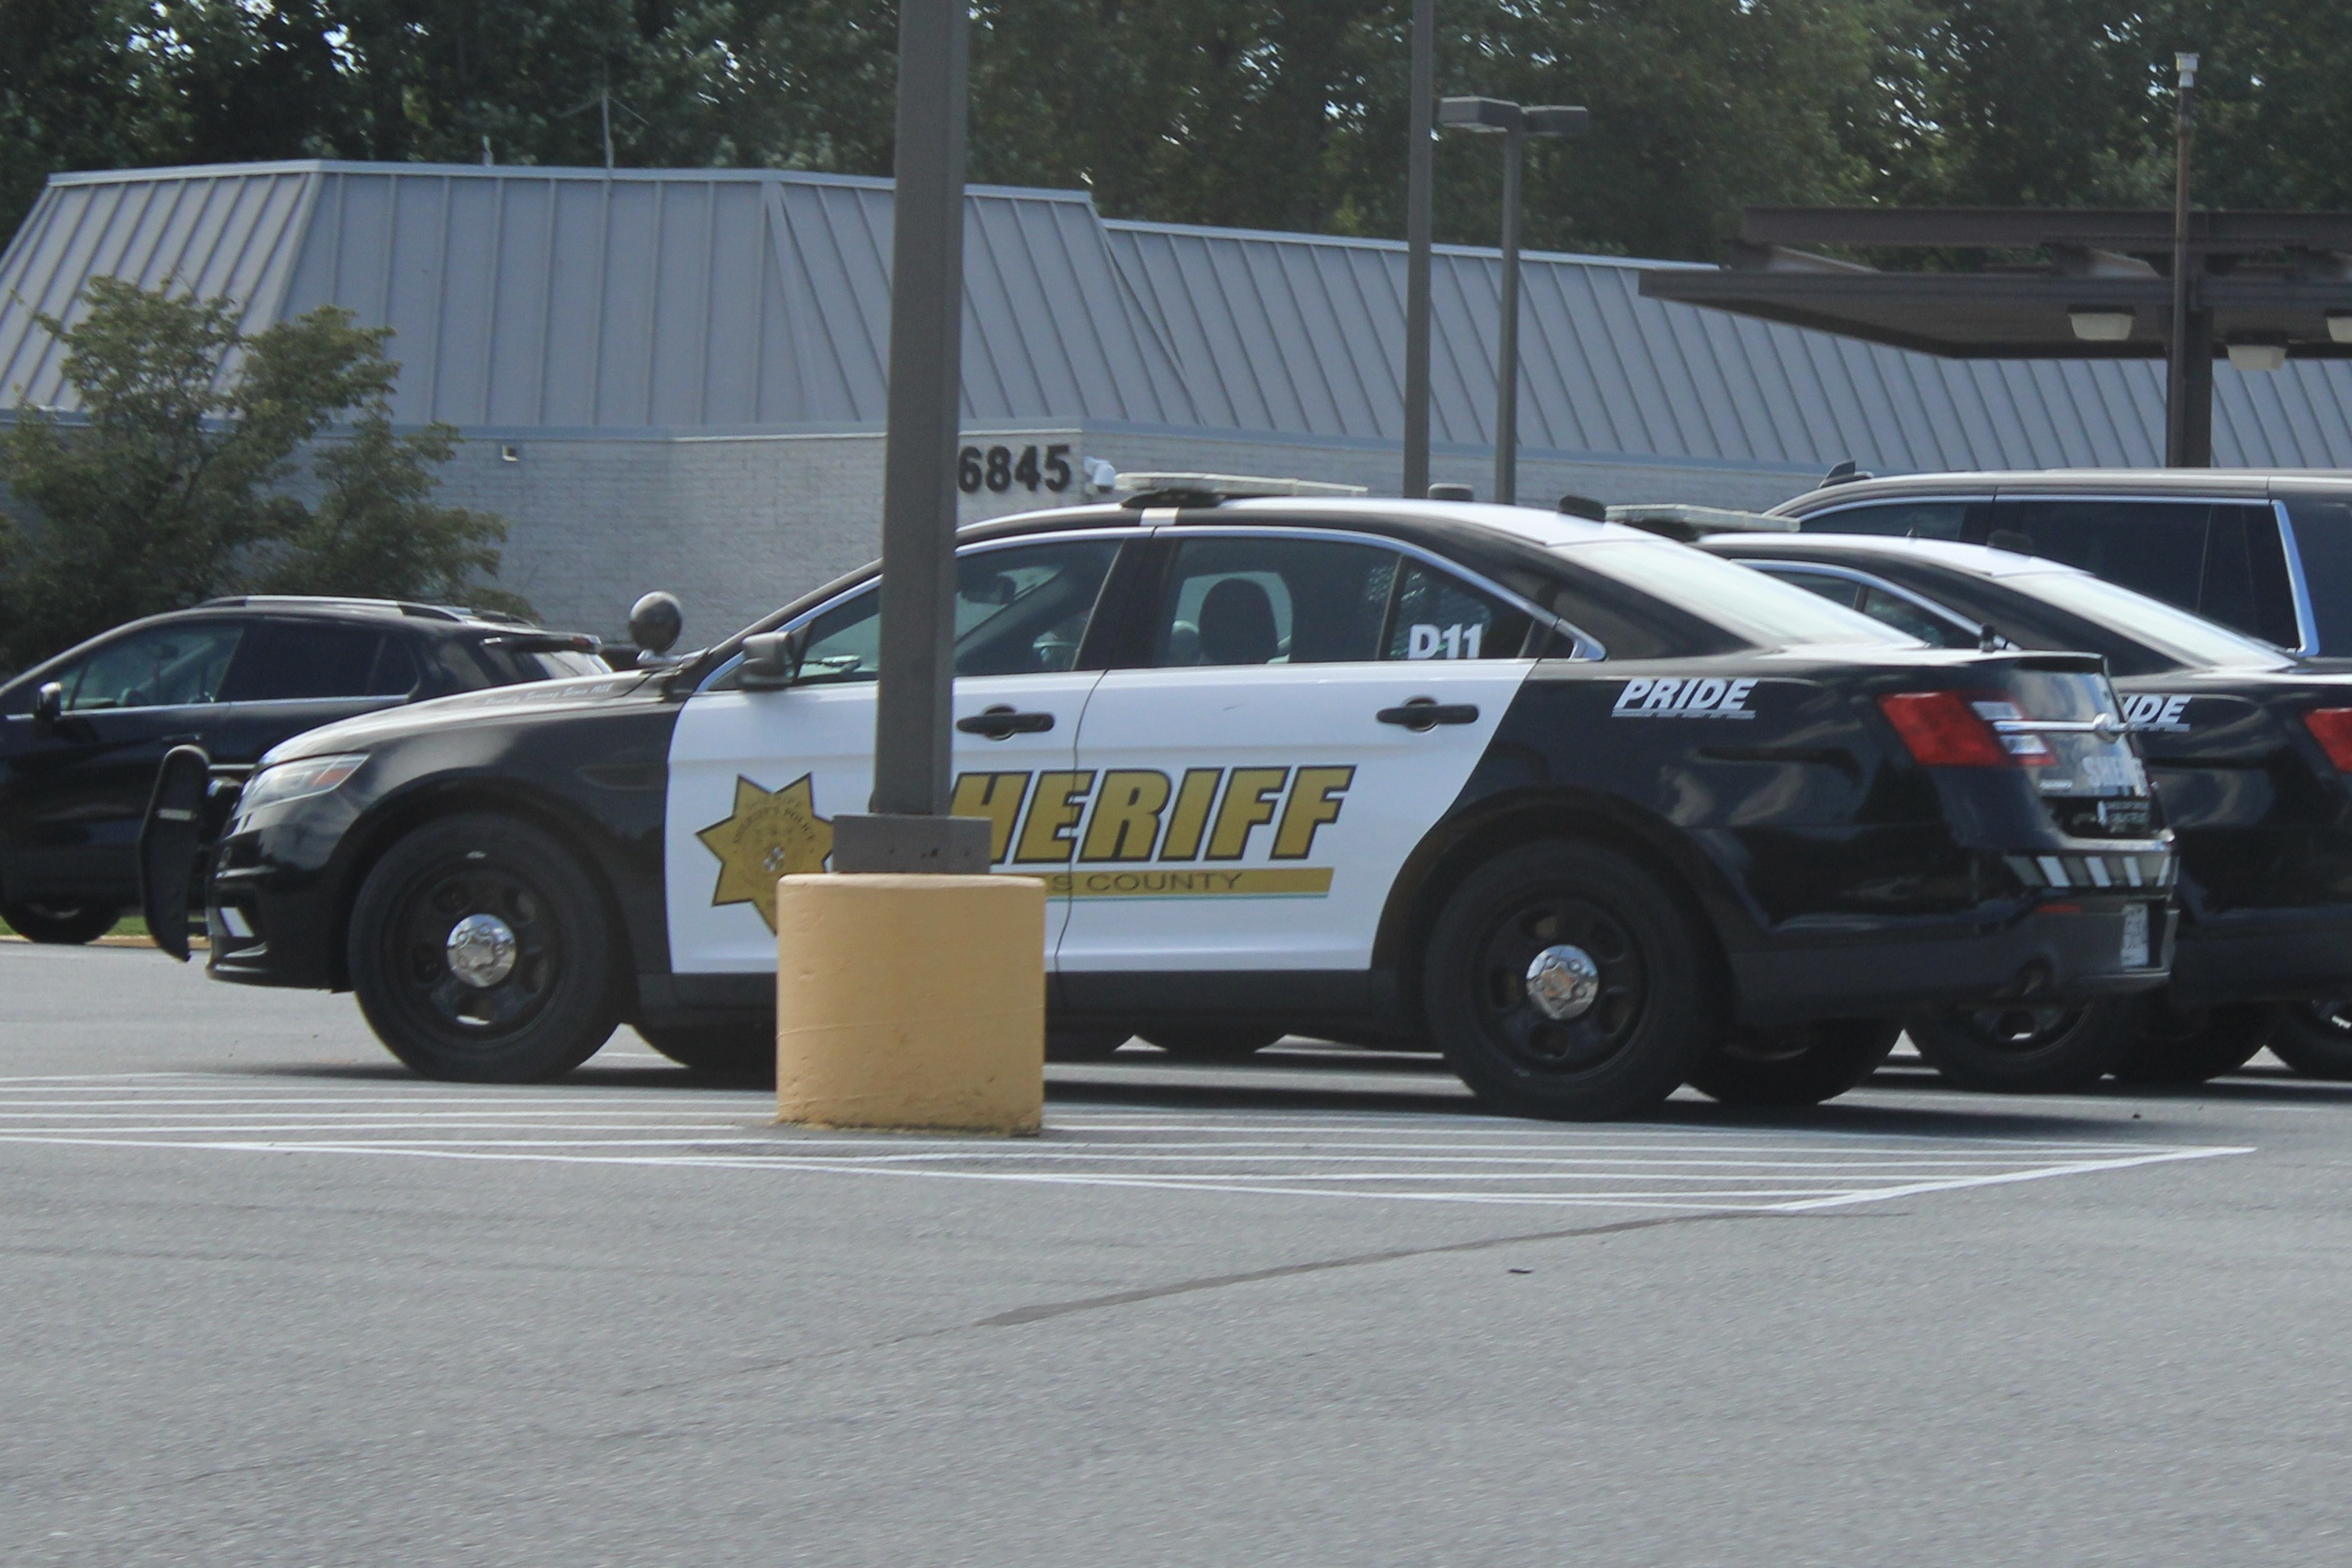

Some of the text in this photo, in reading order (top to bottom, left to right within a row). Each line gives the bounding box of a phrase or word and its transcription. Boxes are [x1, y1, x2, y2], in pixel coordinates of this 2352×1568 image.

[958, 444, 1072, 494] 6845
[1407, 623, 1483, 660] D11
[1613, 678, 1760, 710] PRIDE
[2122, 695, 2193, 724] IDE
[948, 764, 1357, 864] HERIFF
[1086, 872, 1243, 891] COUNTY
